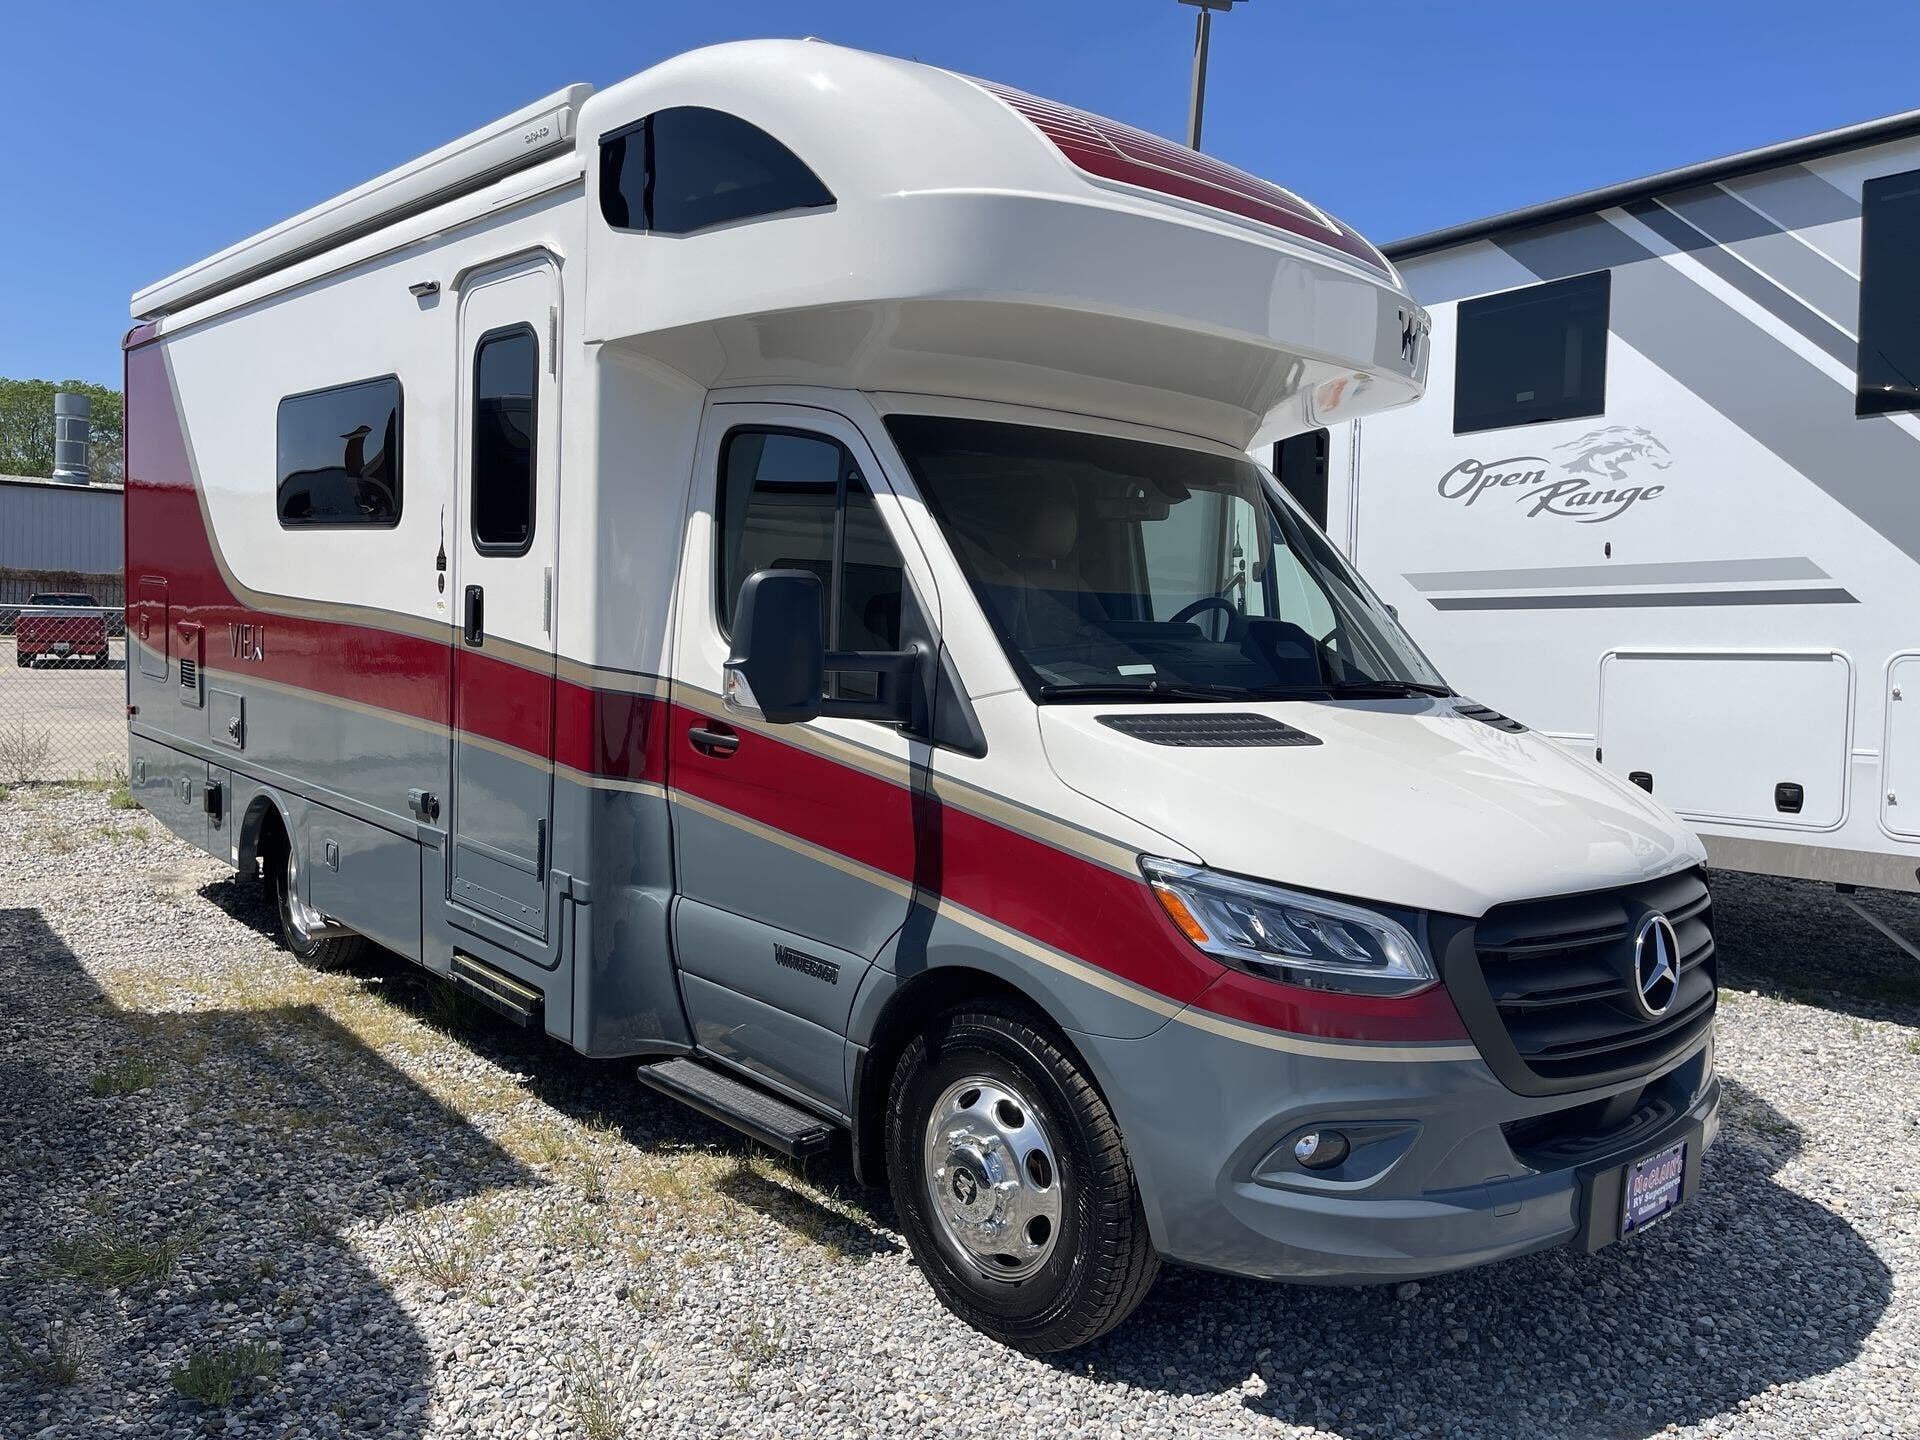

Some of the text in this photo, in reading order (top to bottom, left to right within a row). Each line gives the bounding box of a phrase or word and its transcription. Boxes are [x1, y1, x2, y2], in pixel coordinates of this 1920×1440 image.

[1438, 456, 1551, 506] Open
[1516, 478, 1665, 524] Range
[228, 622, 264, 662] VIEW
[1633, 1194, 1645, 1209] RV
